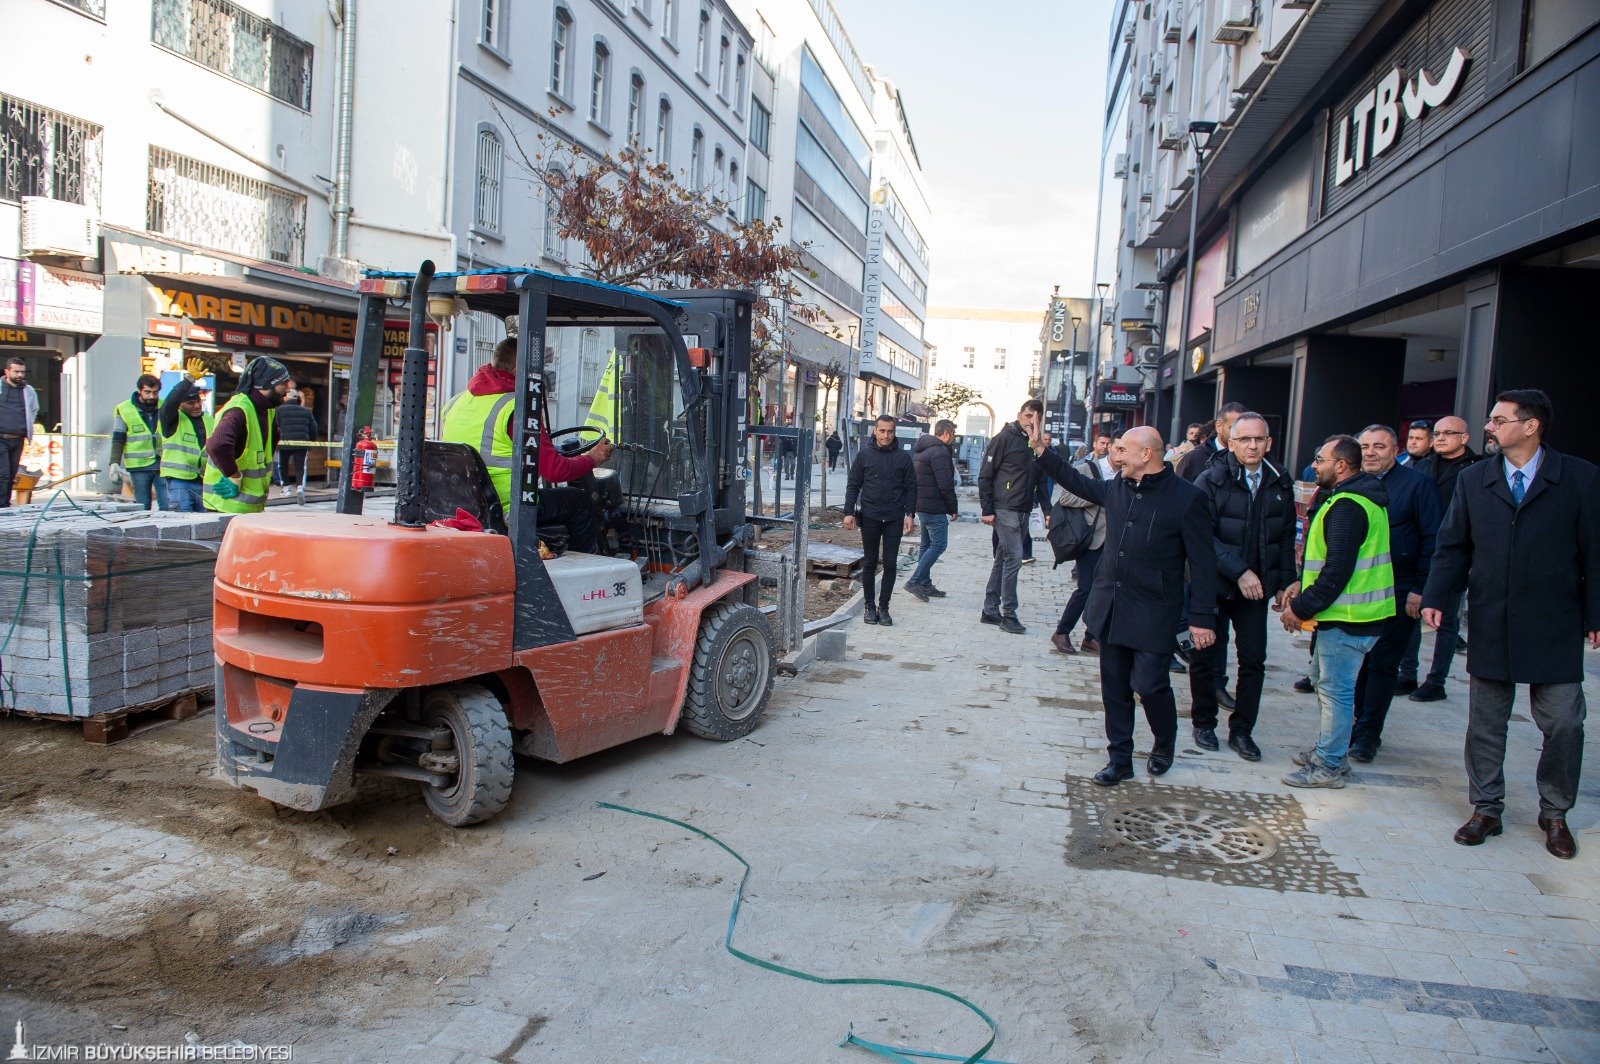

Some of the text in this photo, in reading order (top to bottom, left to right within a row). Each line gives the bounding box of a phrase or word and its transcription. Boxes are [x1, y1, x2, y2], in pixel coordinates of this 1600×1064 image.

[147, 286, 357, 339] YAREN DÖNE
[862, 272, 878, 365] KURUMLARI
[1053, 300, 1066, 342] COLIN'S
[1105, 392, 1137, 401] Kasaba
[522, 381, 542, 503] KİRALIK
[613, 582, 626, 597] 35
